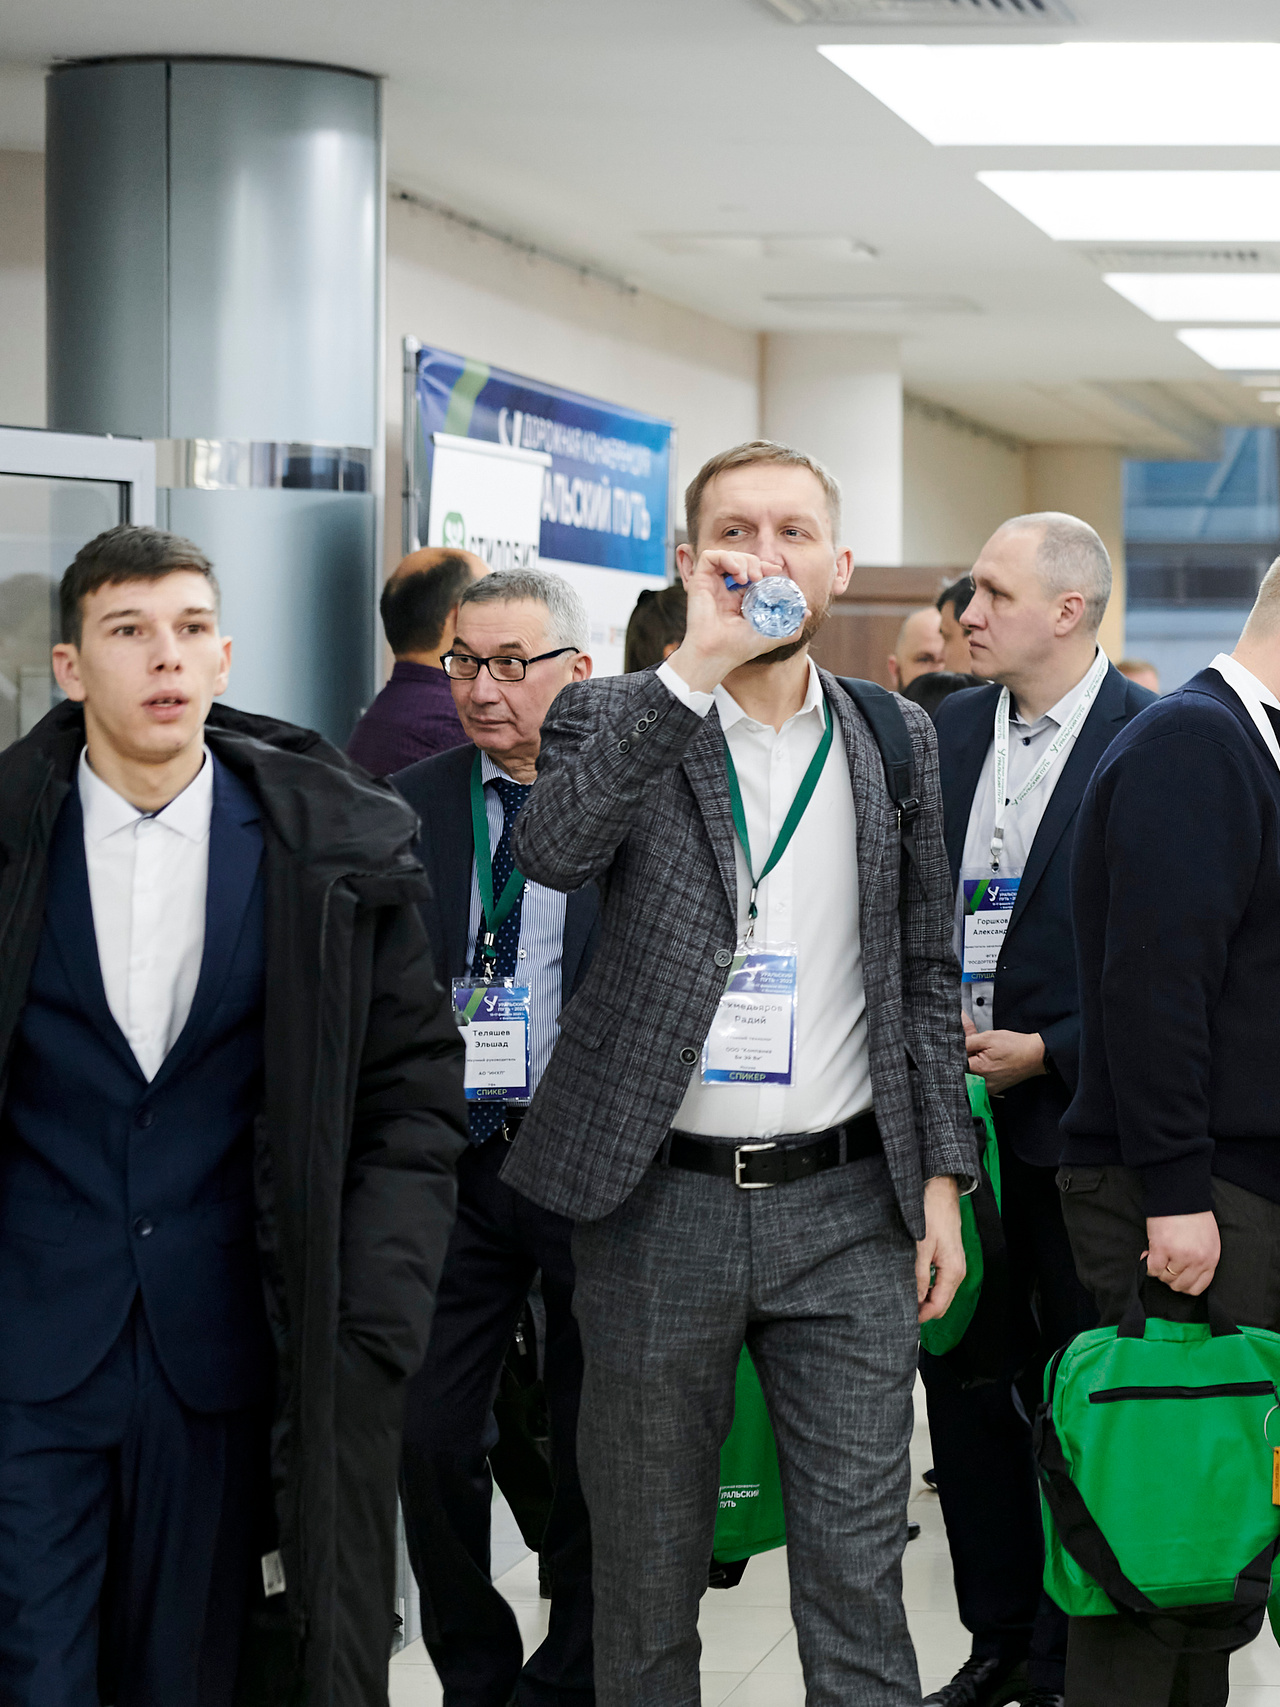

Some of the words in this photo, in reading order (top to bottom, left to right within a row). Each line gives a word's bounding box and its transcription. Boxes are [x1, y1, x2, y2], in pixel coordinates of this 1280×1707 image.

[540, 471, 612, 533] АЛЬСКИЙ
[613, 486, 652, 541] ПУТЬ
[720, 1002, 783, 1012] хмедьяров
[735, 1015, 767, 1025] Радий
[729, 1072, 766, 1081] СПИКЕР
[720, 1489, 760, 1499] УРАЛЬСКИЙ
[720, 1500, 737, 1508] ПУТЬ
